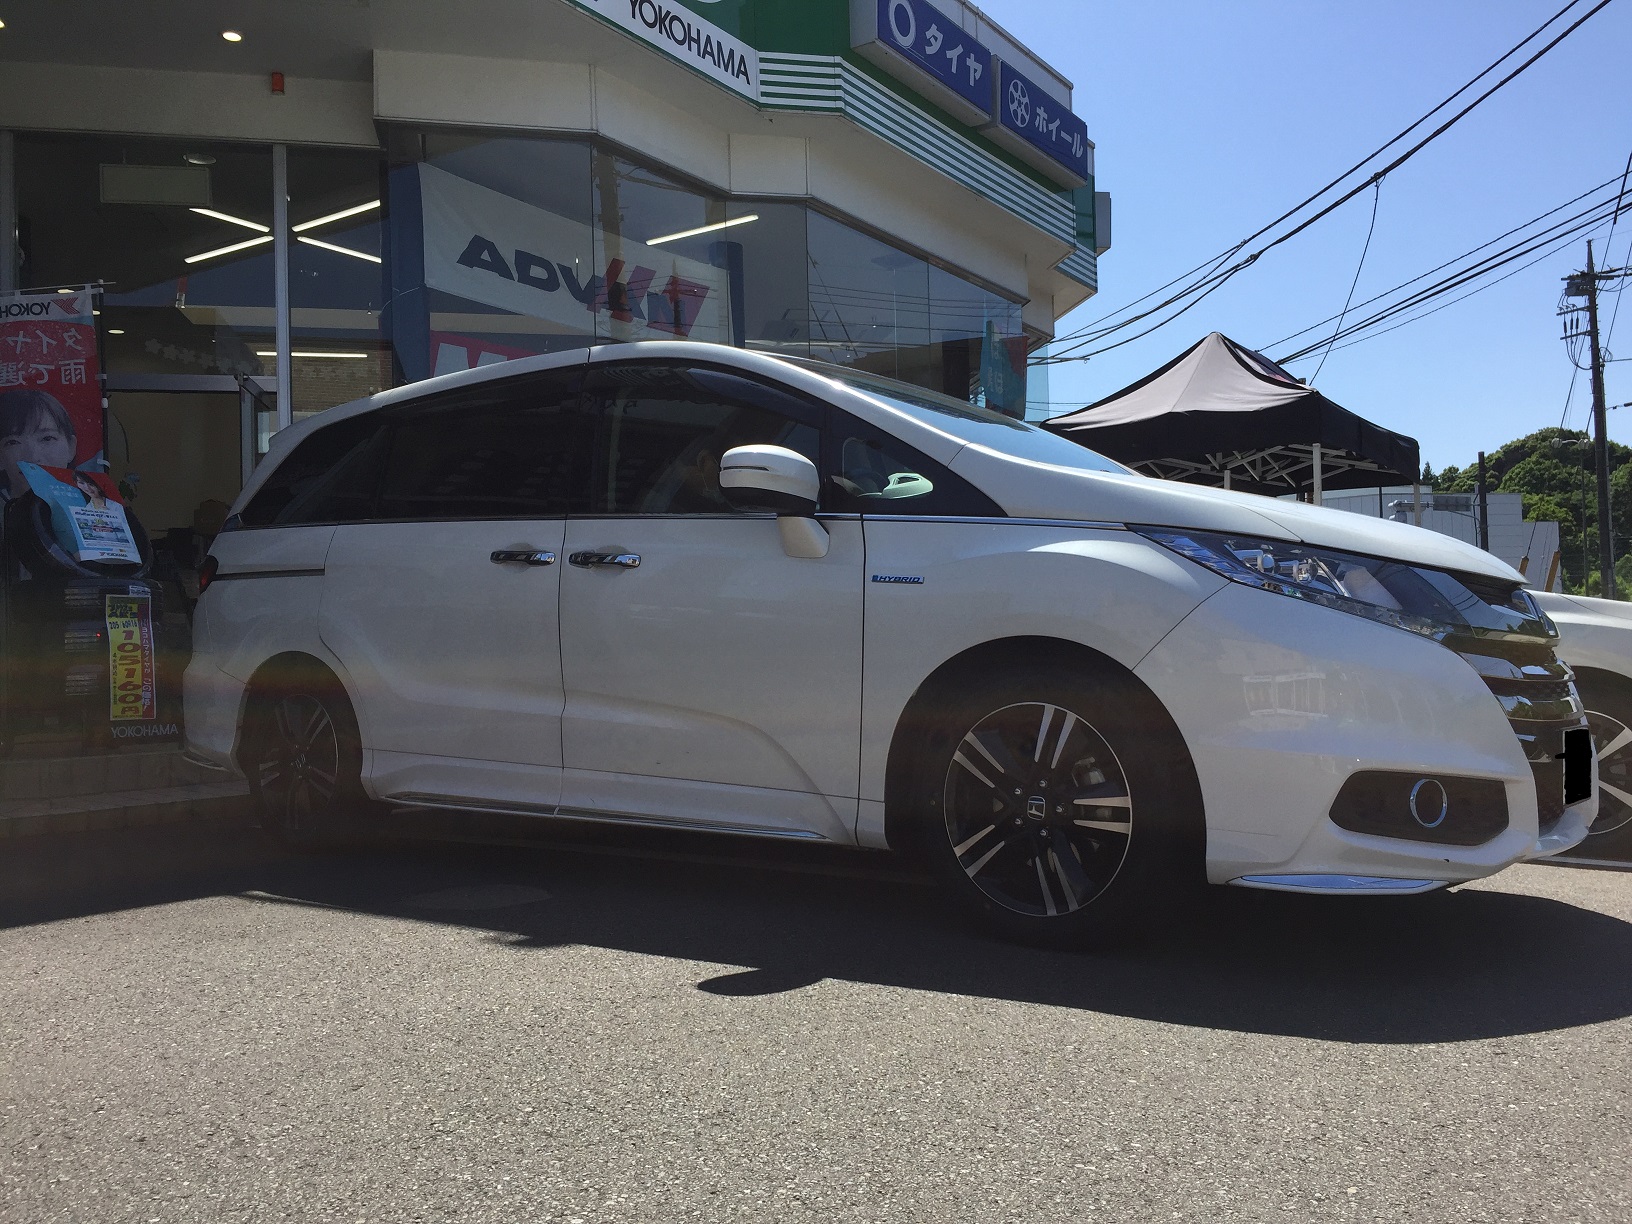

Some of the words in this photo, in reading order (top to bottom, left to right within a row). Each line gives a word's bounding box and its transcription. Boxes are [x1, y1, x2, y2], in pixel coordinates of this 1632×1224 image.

[629, 0, 751, 86] YOKOHAMA
[924, 23, 983, 87] タイヤ
[1034, 106, 1084, 158] ホイール
[879, 575, 921, 583] HYBRID
[110, 723, 179, 739] YOKOHAMA
